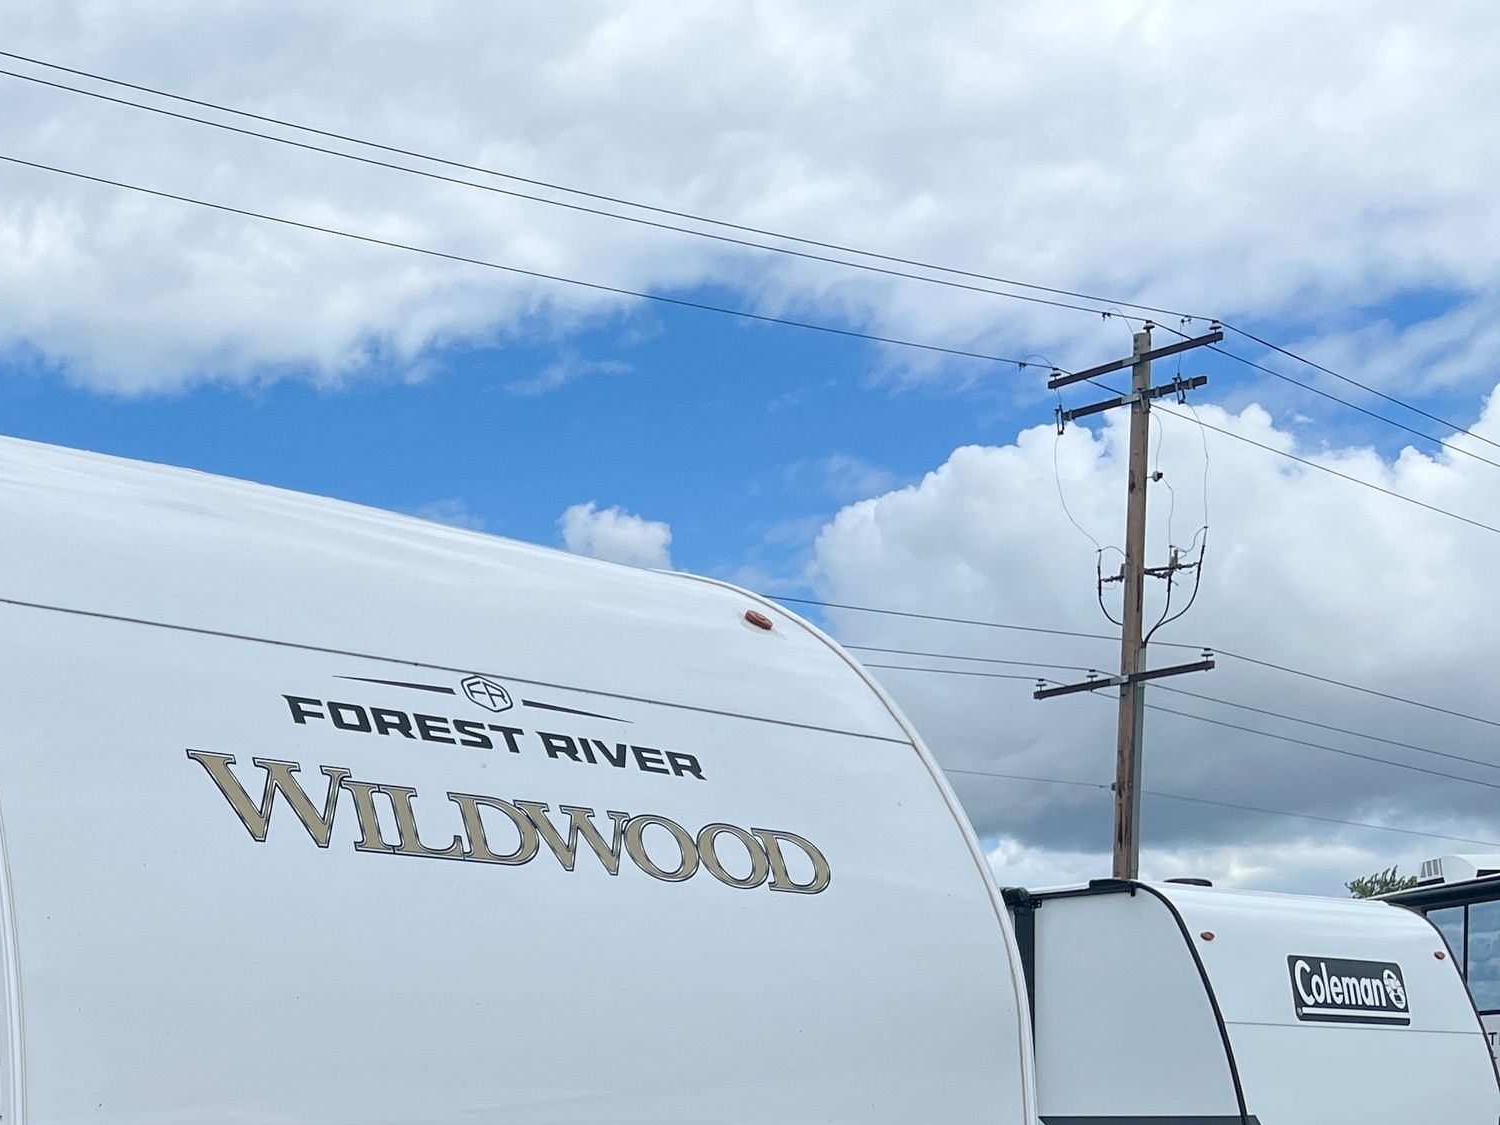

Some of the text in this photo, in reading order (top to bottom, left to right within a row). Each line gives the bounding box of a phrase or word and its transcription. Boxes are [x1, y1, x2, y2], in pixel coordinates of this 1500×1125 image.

[281, 694, 707, 780] FOREST RIVER
[186, 748, 831, 895] WILDWOOD
[1294, 959, 1387, 1006] Coleman
